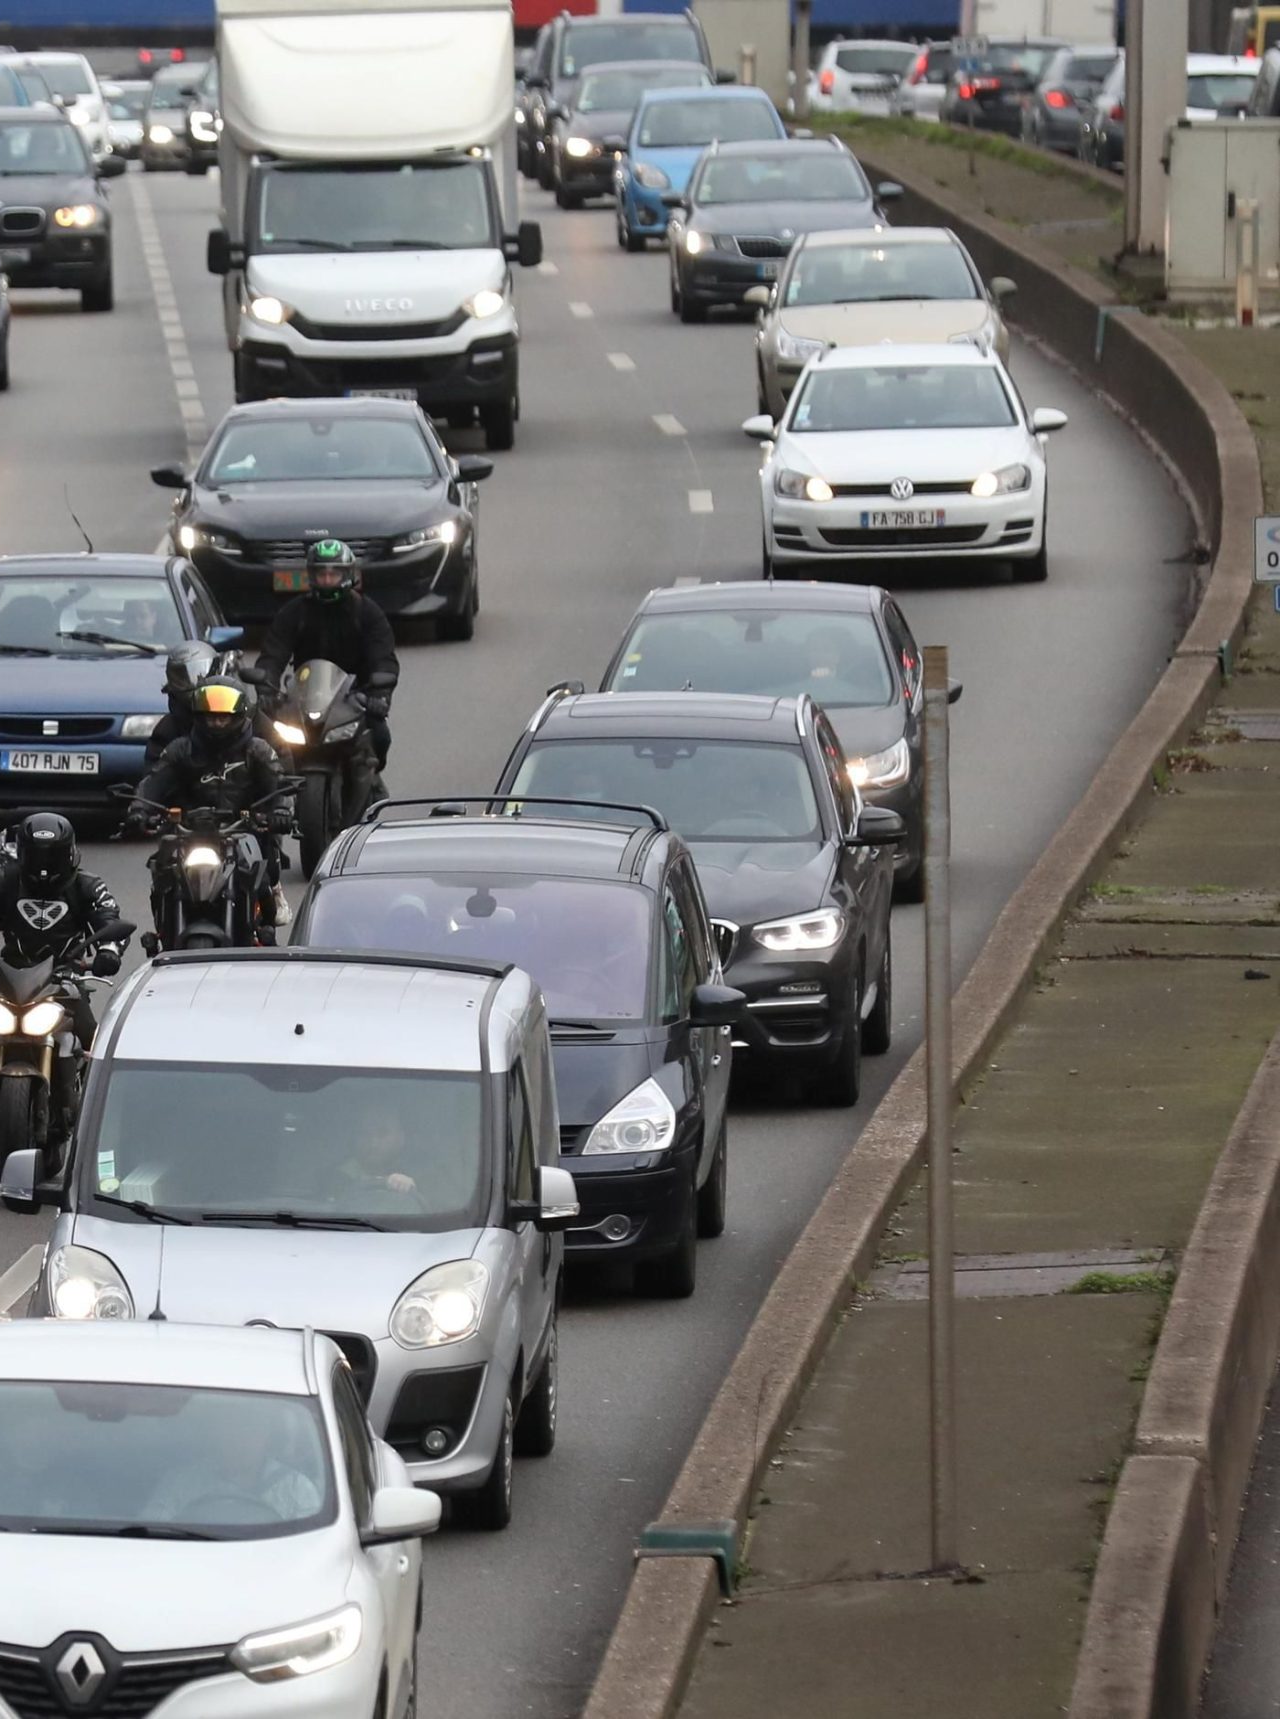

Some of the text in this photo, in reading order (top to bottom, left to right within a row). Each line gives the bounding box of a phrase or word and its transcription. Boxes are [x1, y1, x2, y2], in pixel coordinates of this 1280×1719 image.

[344, 298, 415, 312] IVECO
[11, 753, 39, 769] 407
[76, 755, 96, 771] 75
